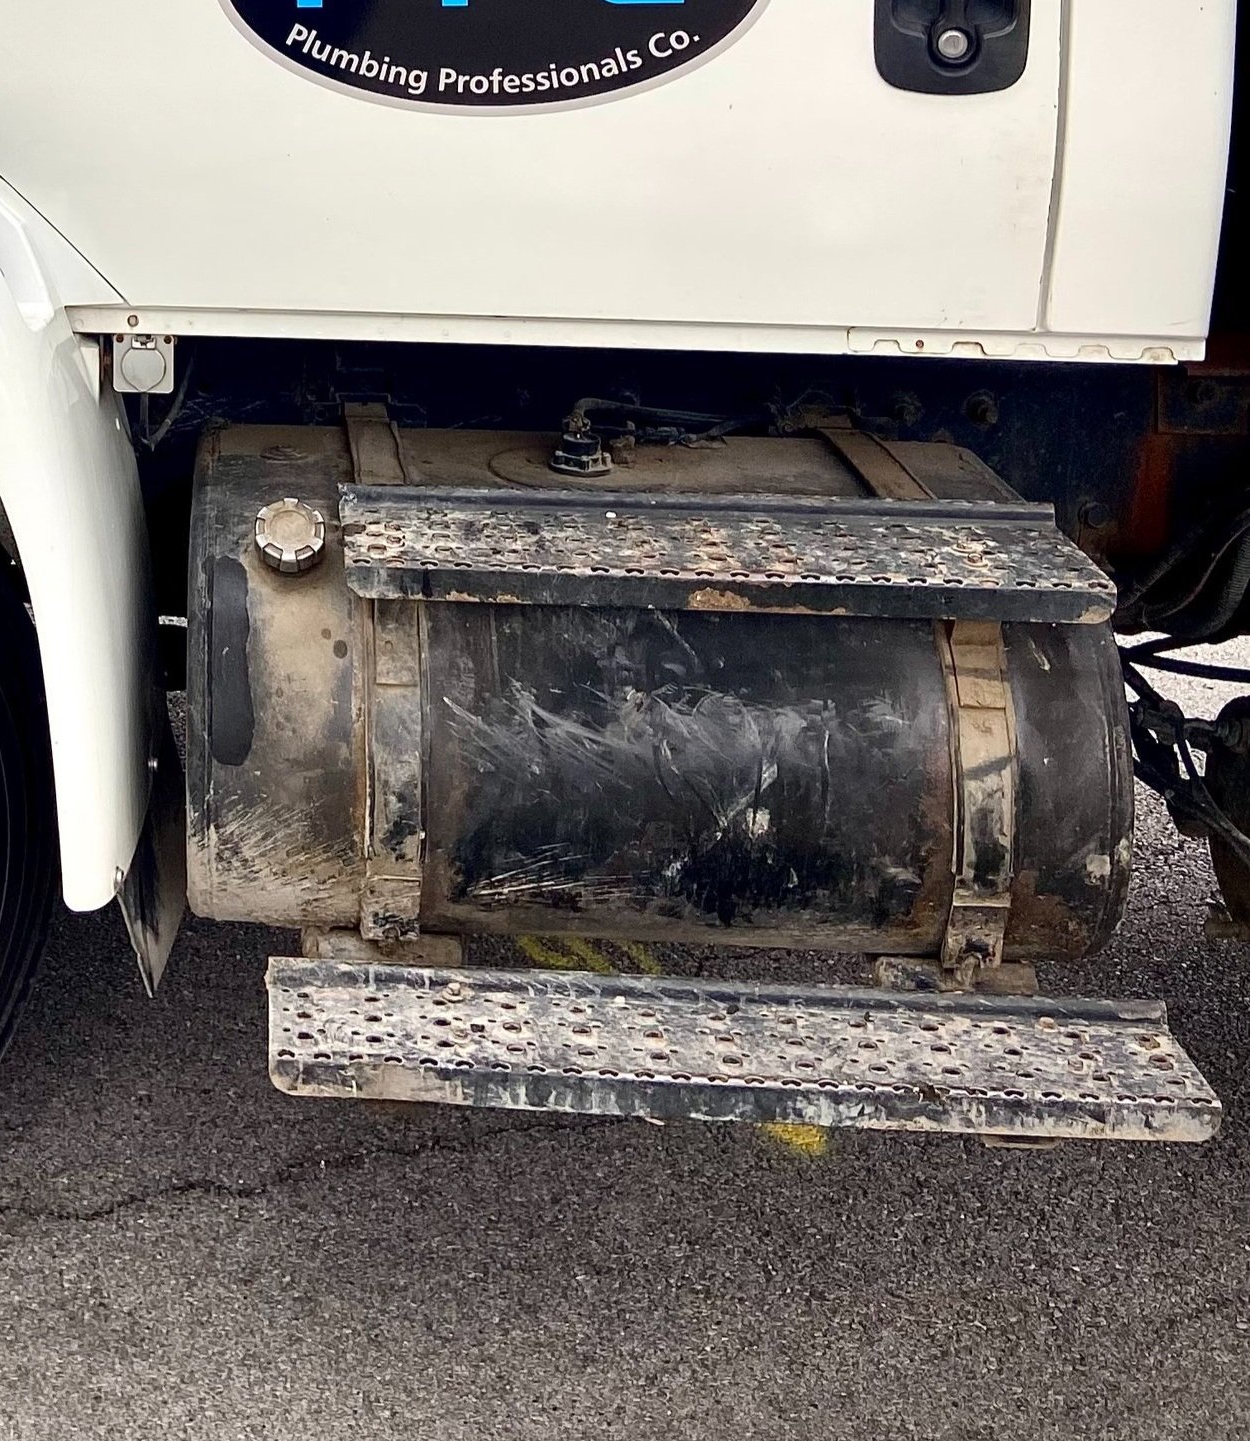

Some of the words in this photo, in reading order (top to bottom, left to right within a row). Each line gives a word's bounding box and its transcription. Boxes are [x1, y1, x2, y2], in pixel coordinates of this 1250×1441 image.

[285, 22, 428, 94] Plumbing
[438, 47, 643, 95] Professionals
[646, 26, 701, 59] Co.
